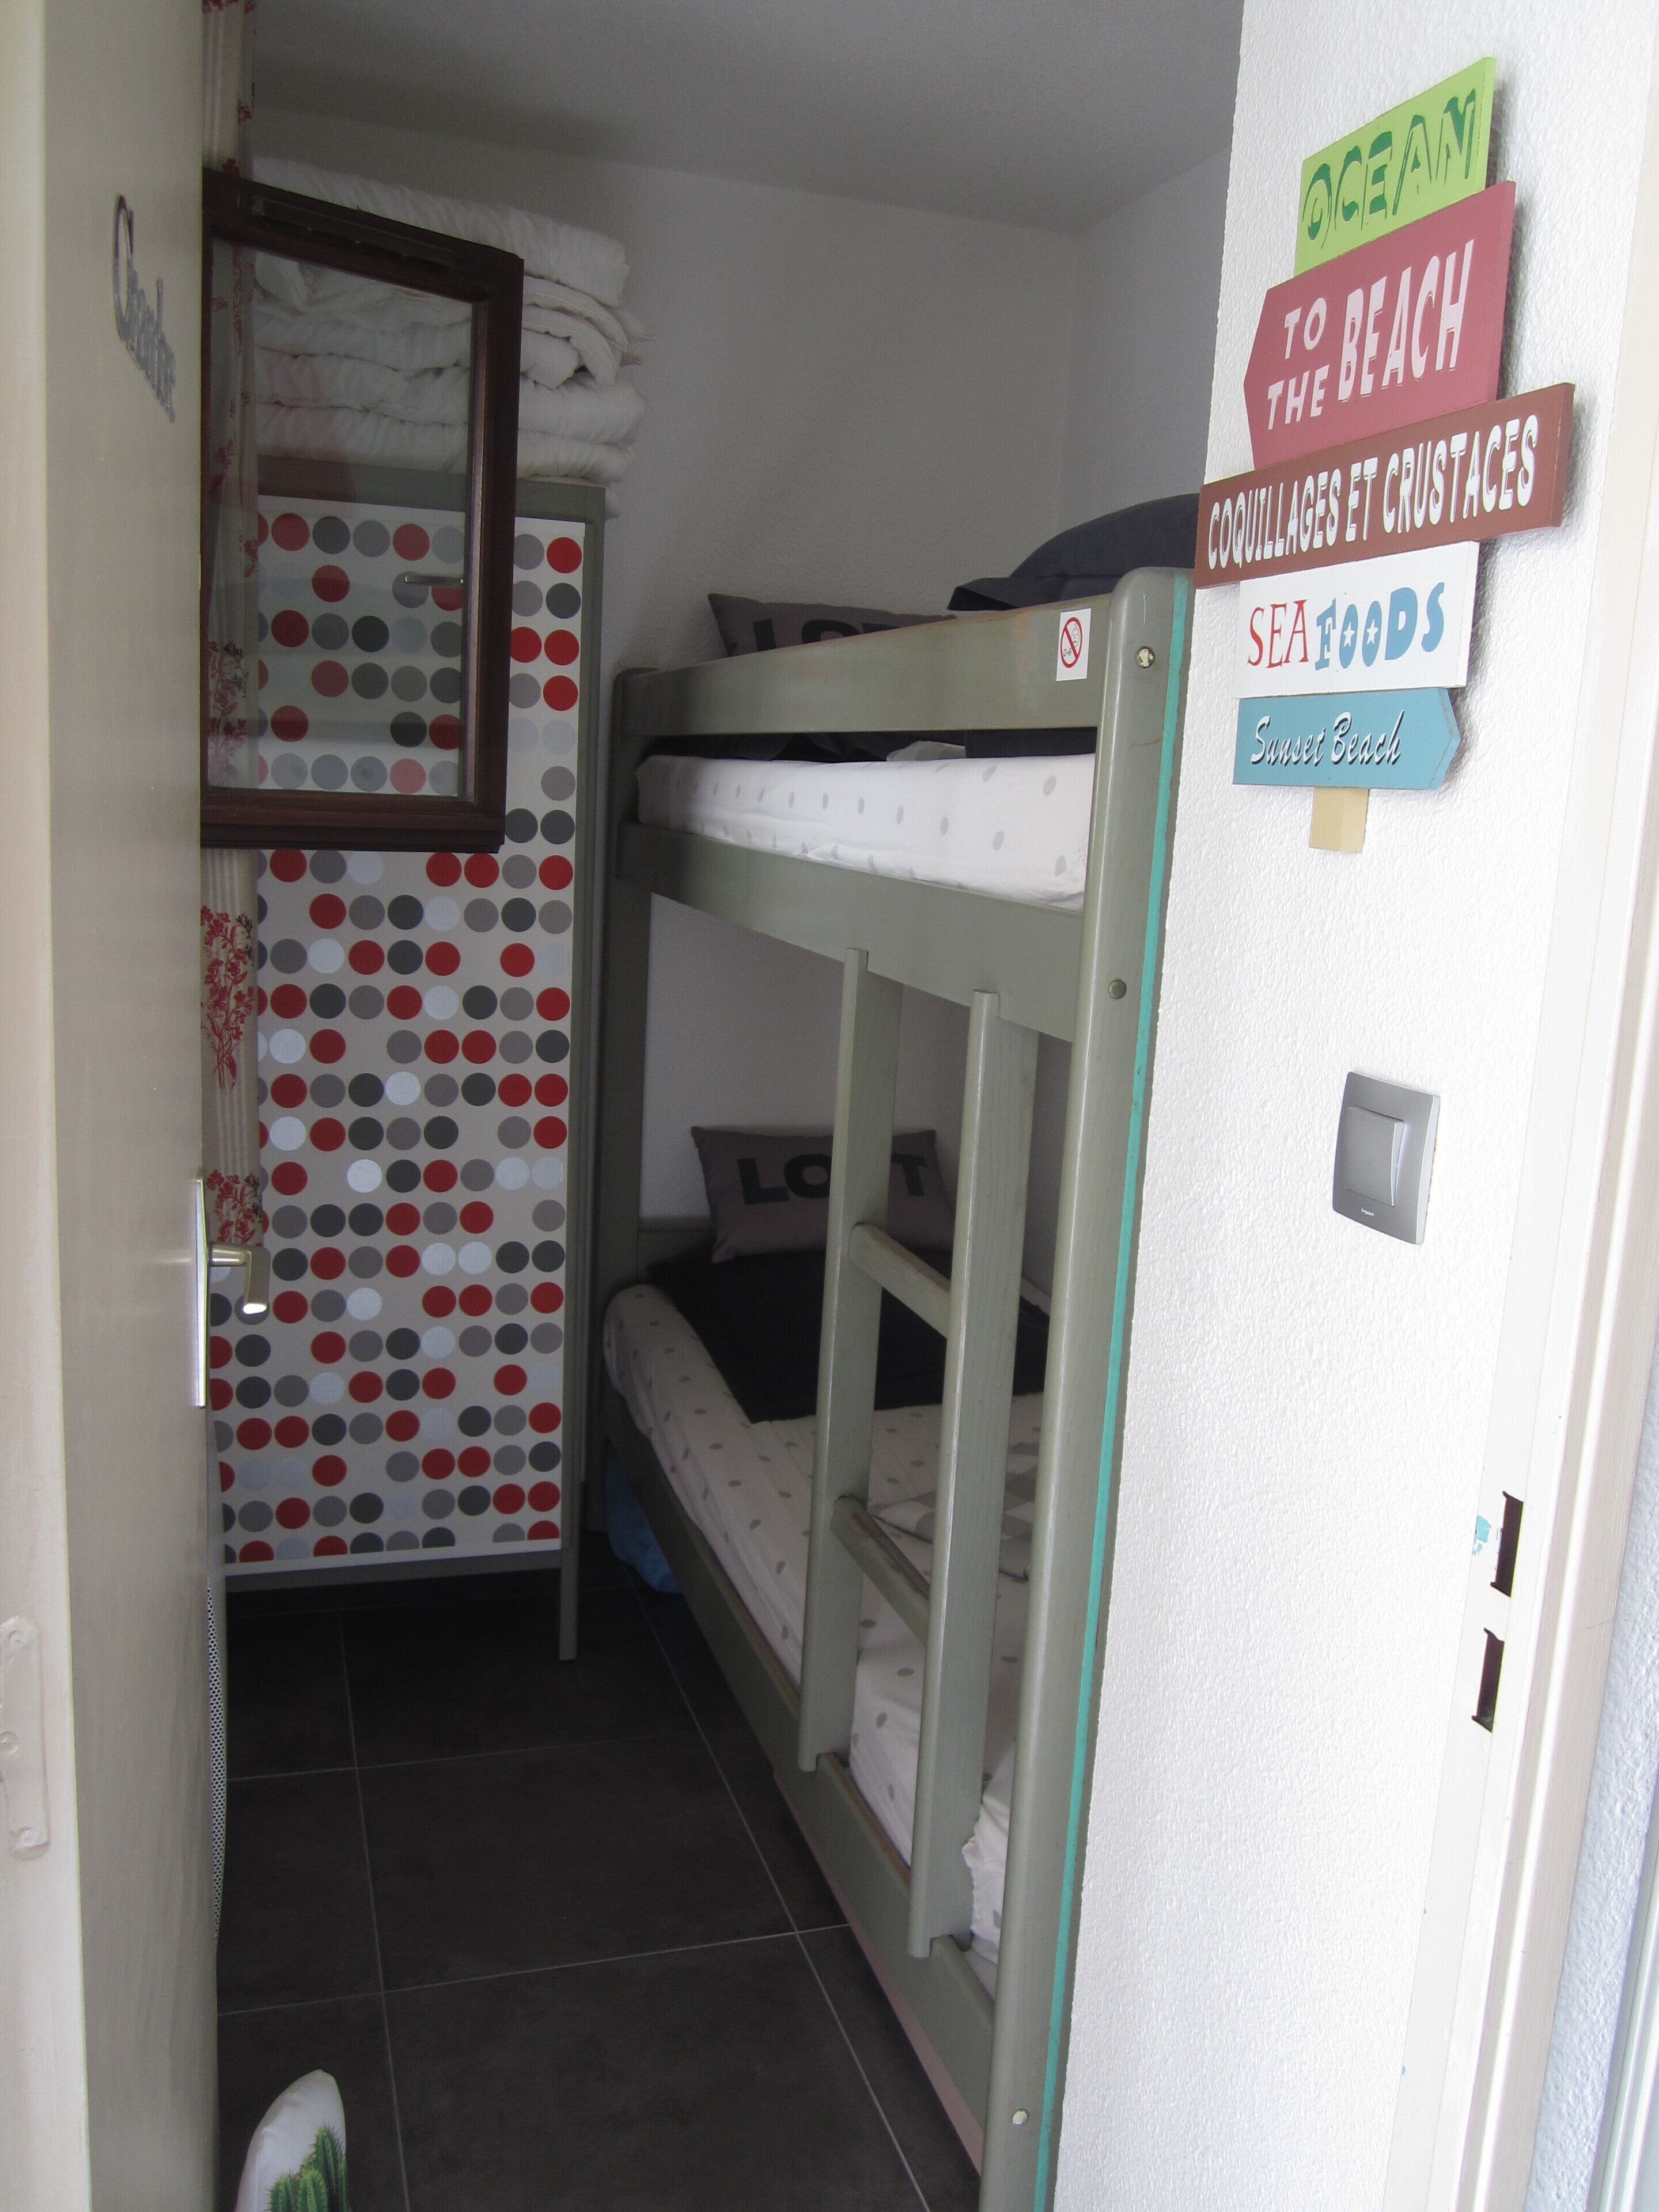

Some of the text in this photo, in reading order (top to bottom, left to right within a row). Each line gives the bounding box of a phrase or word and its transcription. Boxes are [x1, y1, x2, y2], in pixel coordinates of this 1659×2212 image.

[1302, 89, 1476, 249] OCEAN
[1284, 297, 1327, 359] TO
[1338, 239, 1475, 402] BEACH
[1268, 364, 1330, 430] THE
[1209, 414, 1539, 570] COQUILLAGES ET CRUSTACES
[1251, 709, 1405, 767] Sunset Beach
[737, 1153, 929, 1205] LOT
